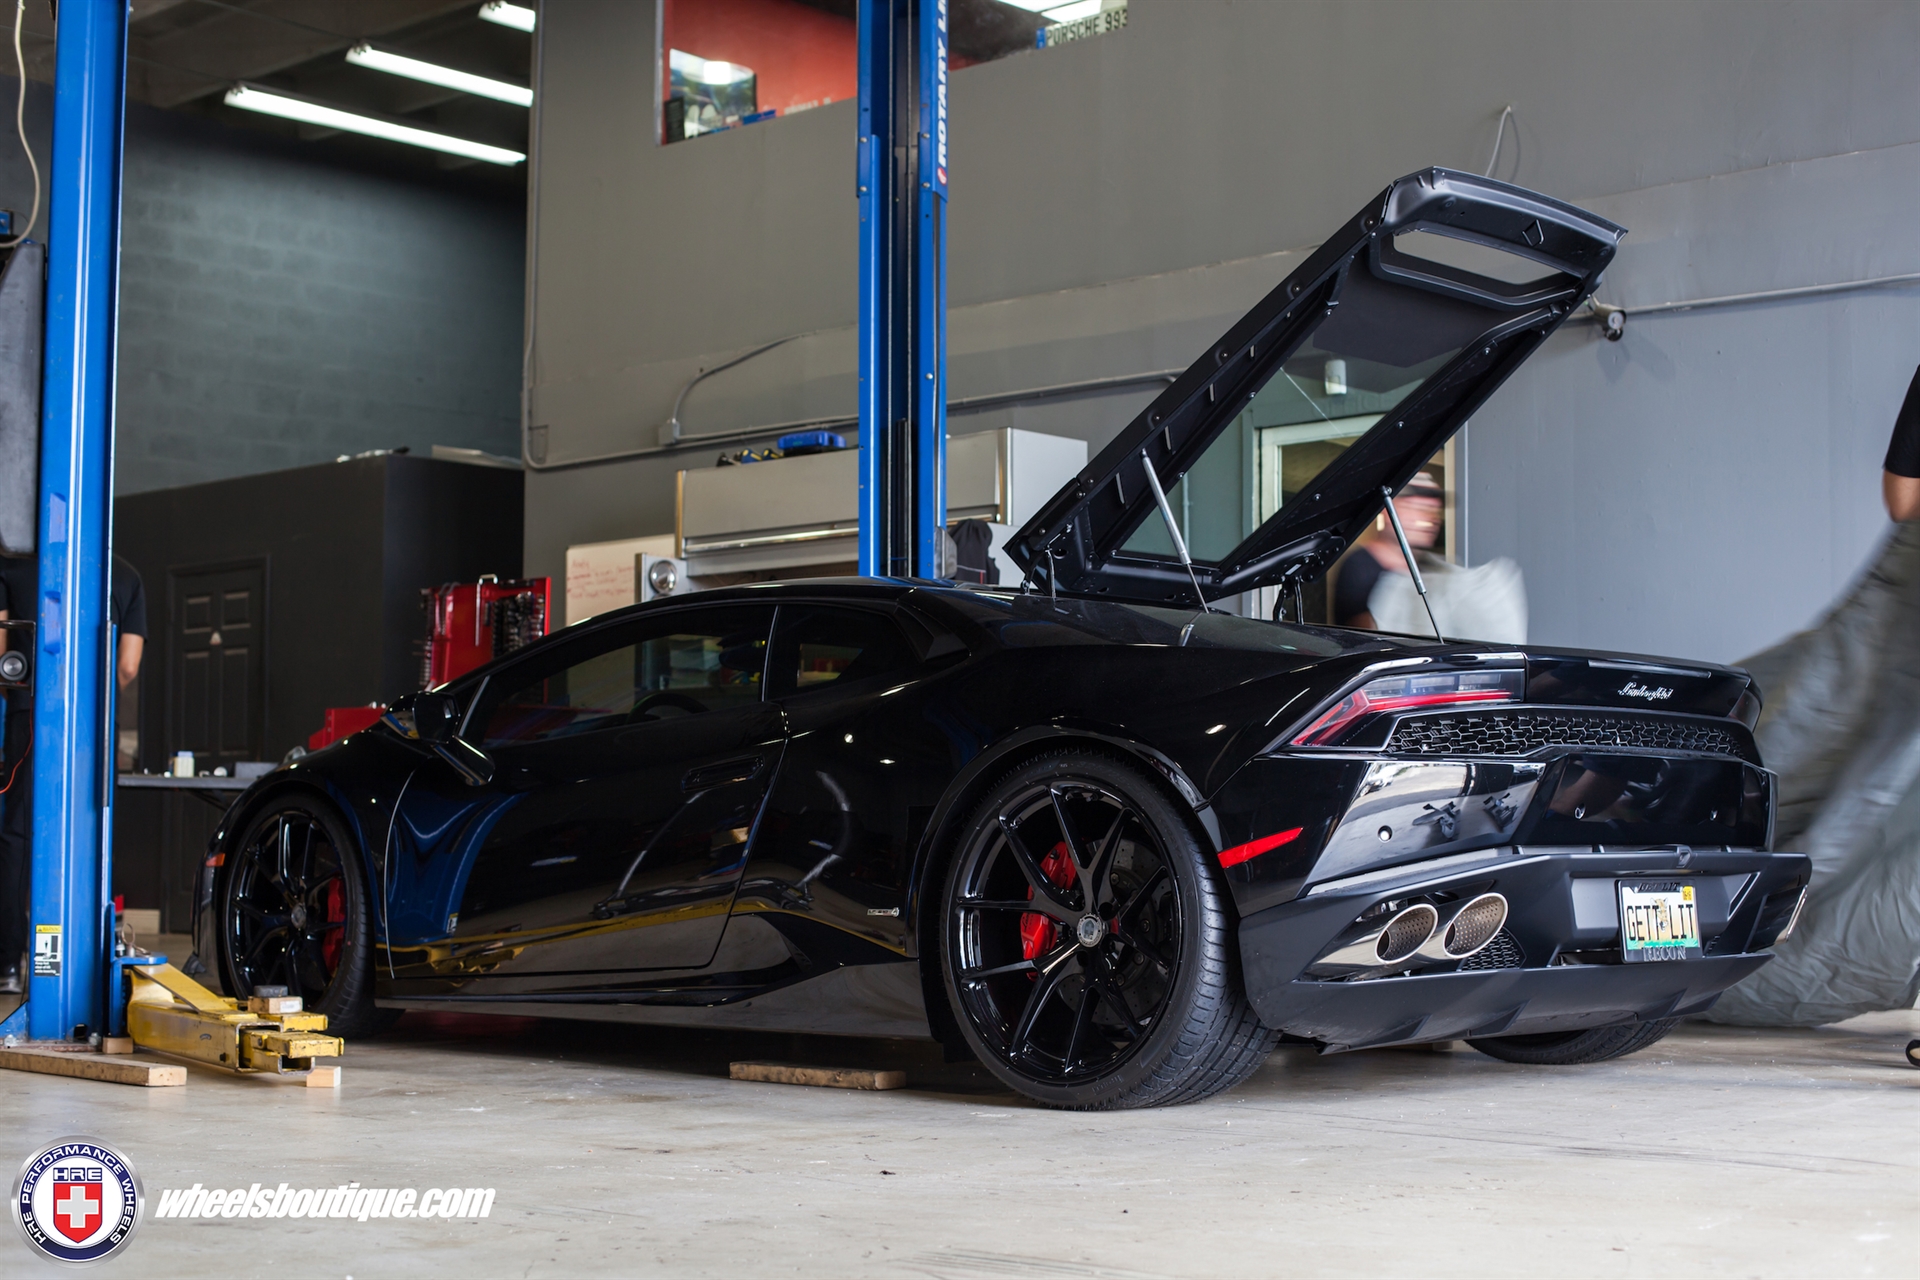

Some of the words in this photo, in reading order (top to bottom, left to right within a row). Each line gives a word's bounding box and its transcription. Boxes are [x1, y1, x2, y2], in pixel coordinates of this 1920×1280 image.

[937, 0, 947, 33] LI
[1046, 16, 1100, 46] PORSCHE
[1104, 8, 1128, 32] 993
[937, 37, 947, 168] ROTARY
[1626, 904, 1660, 941] GETT
[1668, 903, 1694, 940] LIT
[1643, 945, 1687, 962] RECON
